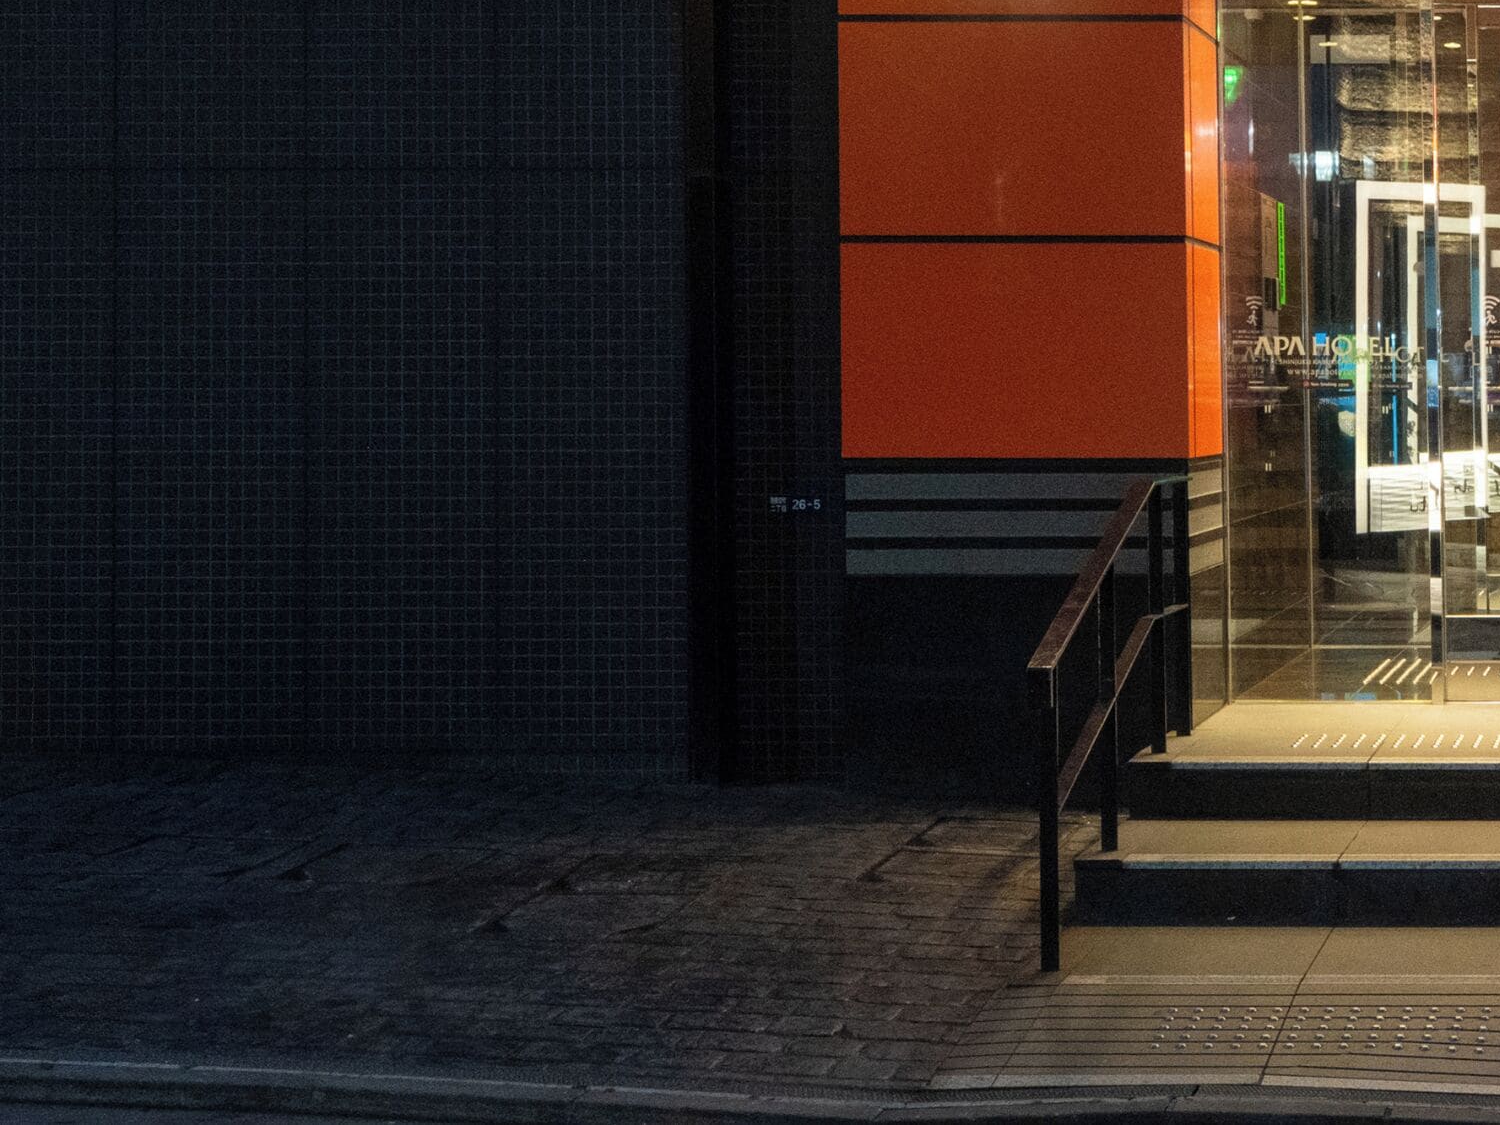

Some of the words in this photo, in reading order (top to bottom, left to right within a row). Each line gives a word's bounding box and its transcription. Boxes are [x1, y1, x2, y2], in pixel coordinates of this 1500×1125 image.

[1254, 335, 1306, 356] APA
[1312, 335, 1395, 356] HOEL
[791, 498, 821, 510] 26-5
